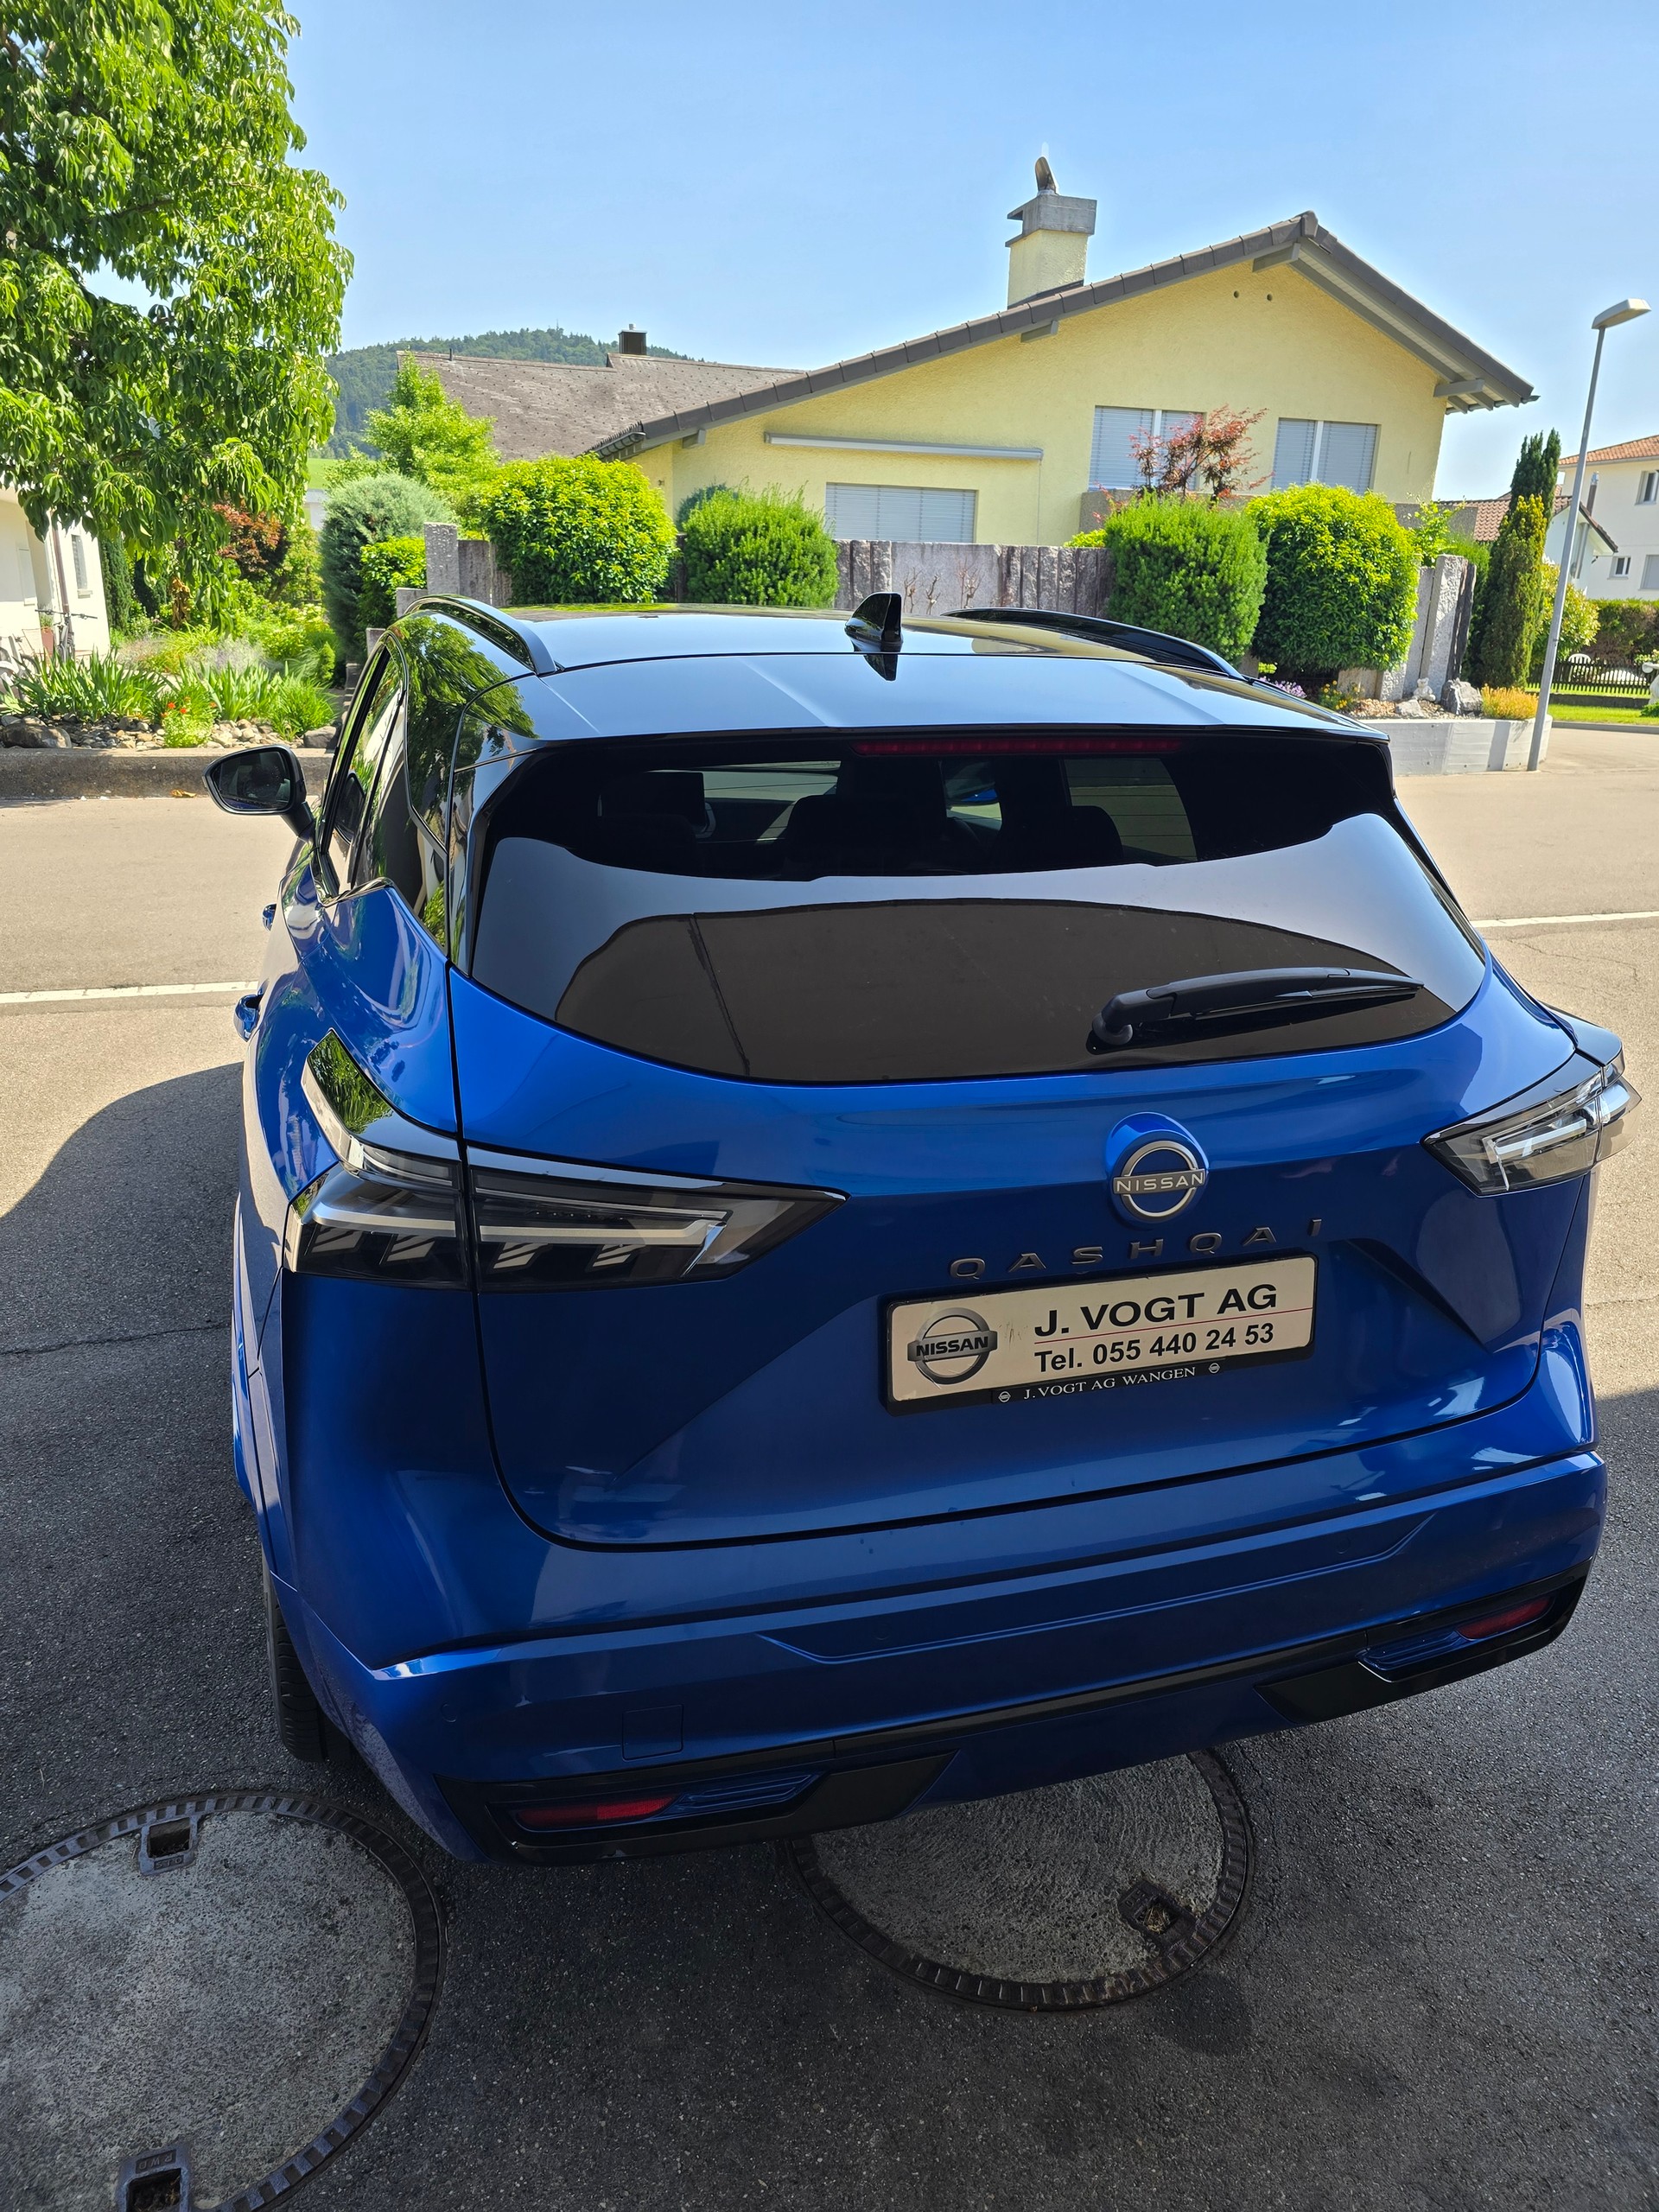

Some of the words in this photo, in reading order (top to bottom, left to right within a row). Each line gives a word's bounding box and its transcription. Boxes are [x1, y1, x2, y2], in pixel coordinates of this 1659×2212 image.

[1116, 1172, 1204, 1192] NISSAN
[949, 1219, 1323, 1281] QASHQAI
[1034, 1309, 1071, 1338] J.
[1080, 1292, 1205, 1331] VOGT
[1217, 1283, 1277, 1315] AG
[916, 1336, 988, 1357] NISSAN
[1034, 1347, 1083, 1373] Tel.
[1092, 1338, 1141, 1365] 055
[1149, 1332, 1198, 1357] 440
[1205, 1326, 1237, 1351] 24
[1244, 1322, 1274, 1346] 53
[1090, 1377, 1116, 1390] AG
[1122, 1366, 1197, 1386] WANGEN
